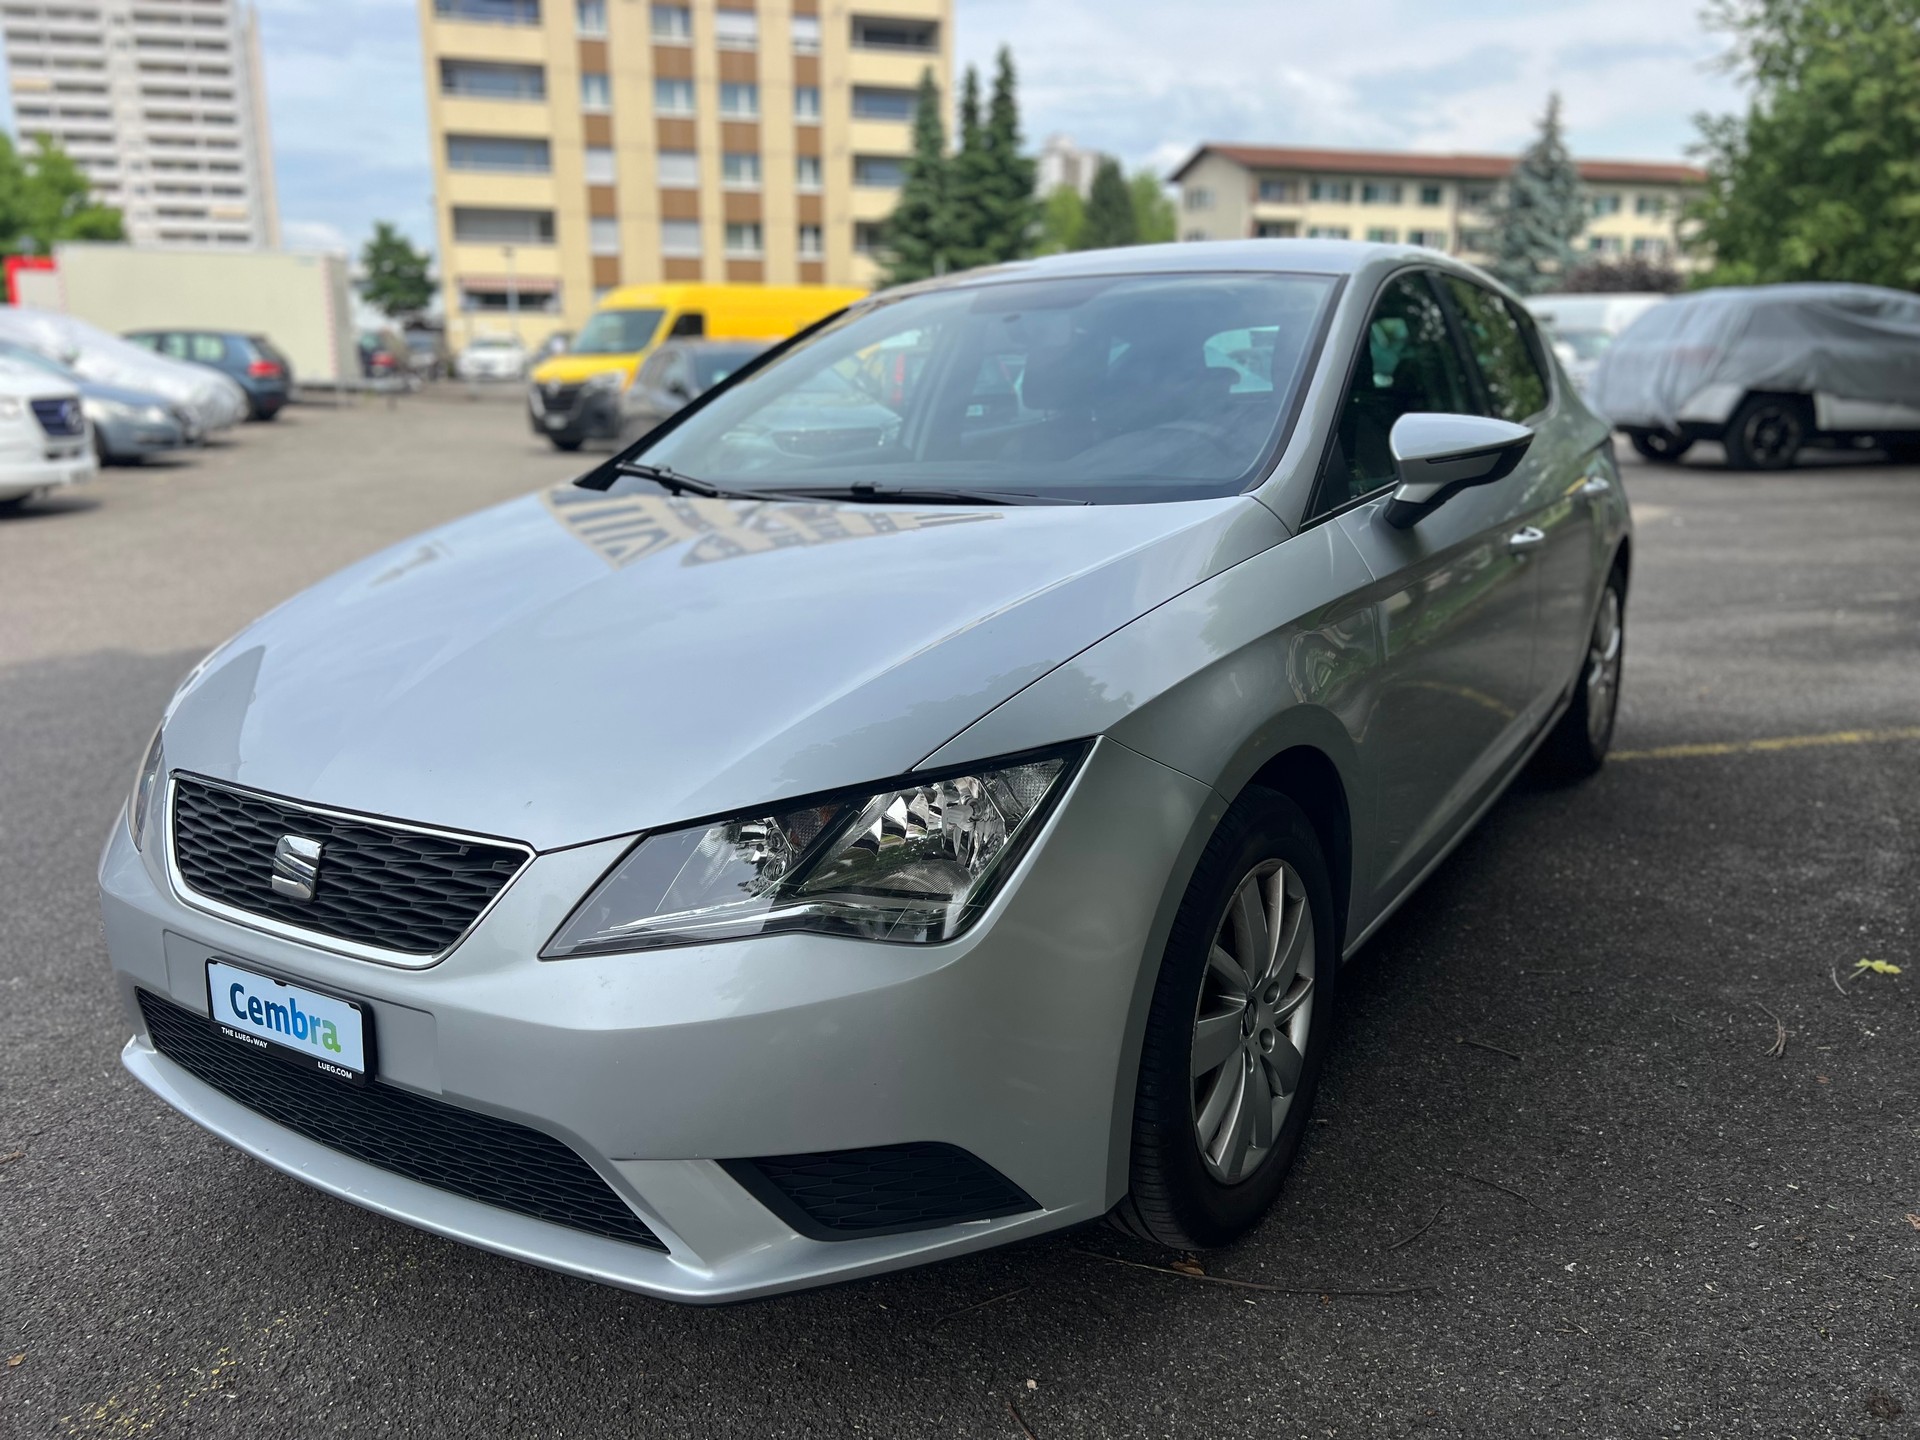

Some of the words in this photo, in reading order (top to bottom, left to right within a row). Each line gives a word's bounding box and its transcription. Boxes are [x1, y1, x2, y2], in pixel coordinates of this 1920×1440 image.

[230, 982, 342, 1053] Cembra
[221, 1026, 234, 1037] THE
[317, 1061, 353, 1080] LUEG.COM
